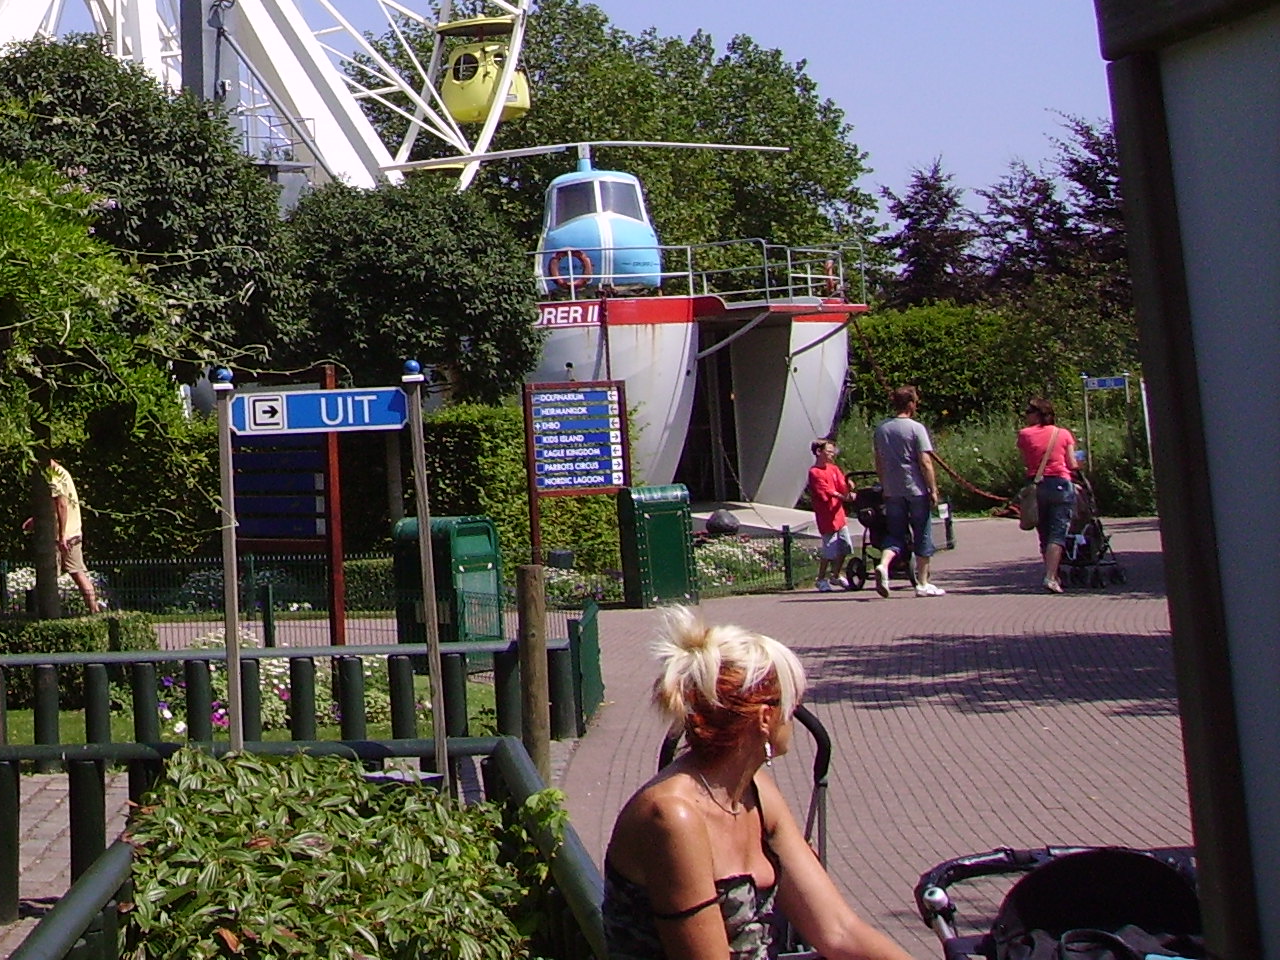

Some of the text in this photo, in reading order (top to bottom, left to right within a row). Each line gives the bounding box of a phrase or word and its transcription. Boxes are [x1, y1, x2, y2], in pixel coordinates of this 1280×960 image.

[320, 395, 377, 426] UIT
[542, 434, 585, 444] KIDS ISLAND
[543, 447, 601, 457] EAGLE KINGDOM
[544, 461, 599, 472] PARROTS CIRCUS
[545, 475, 605, 486] NORDIC LAGOON
